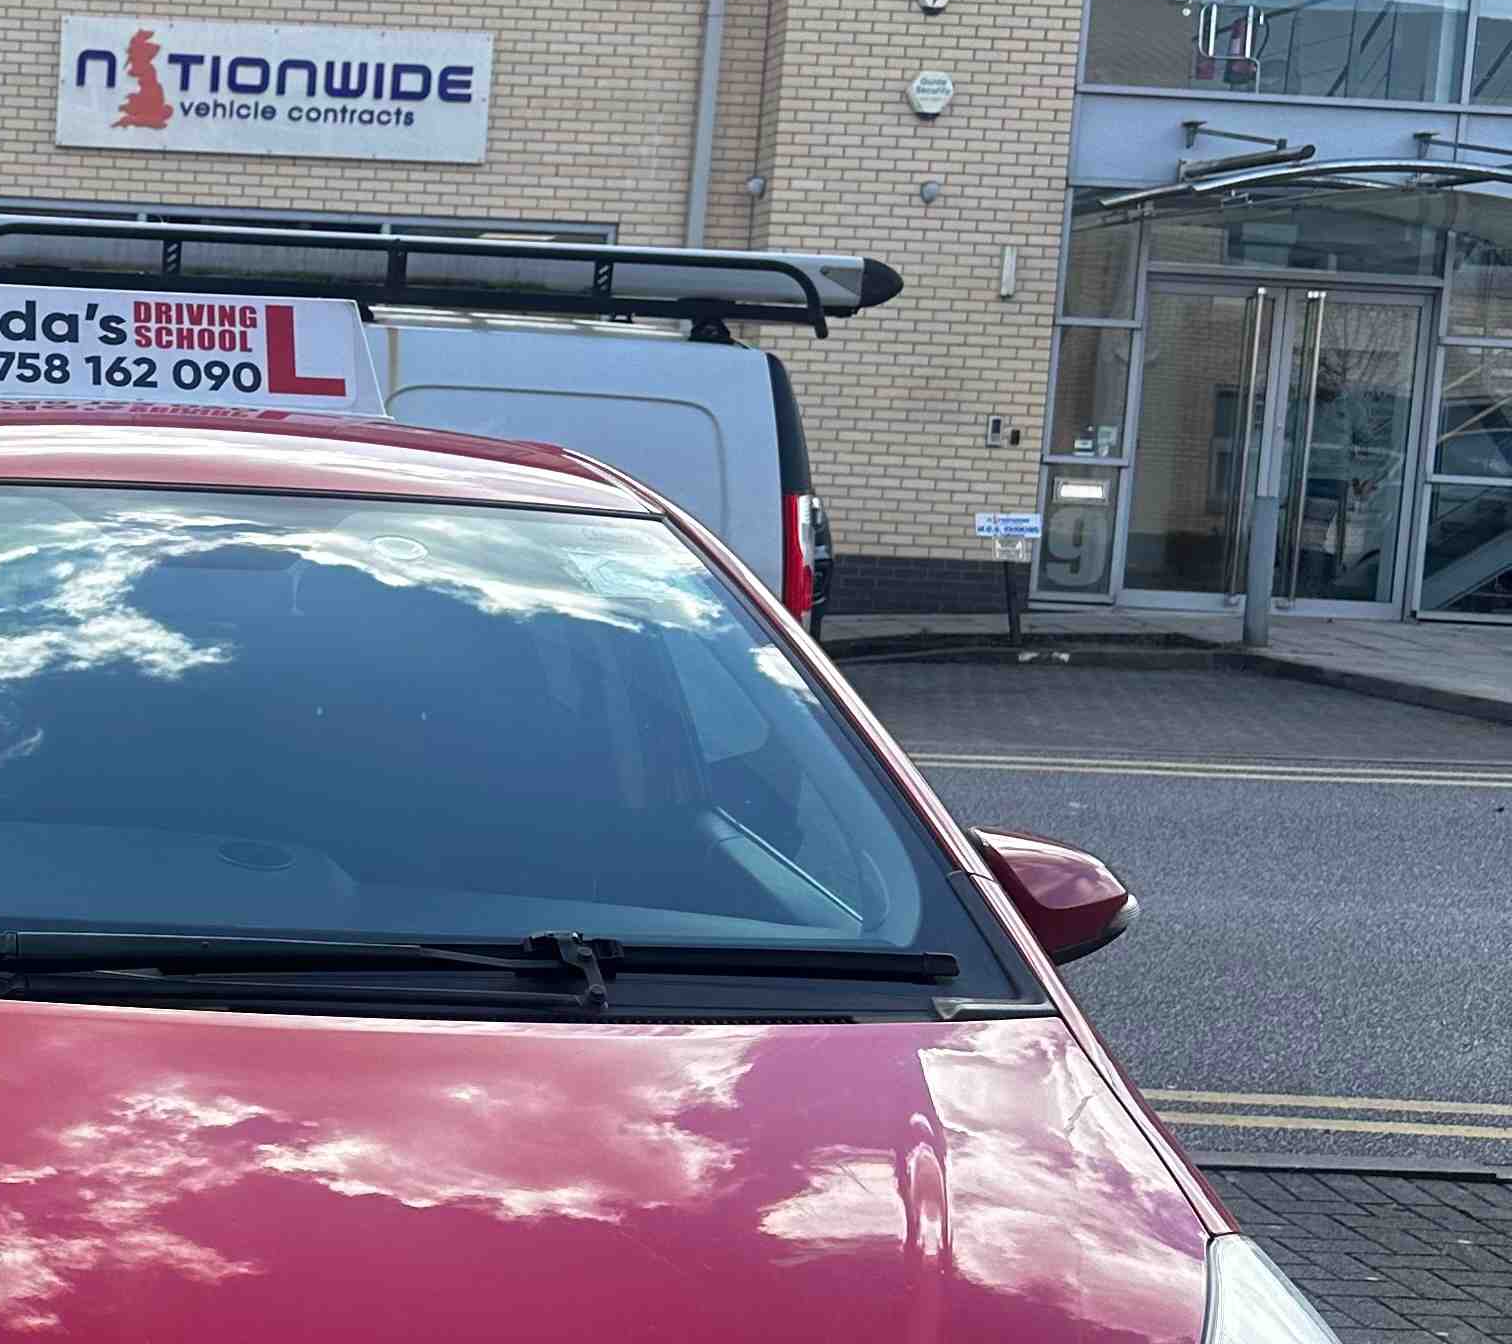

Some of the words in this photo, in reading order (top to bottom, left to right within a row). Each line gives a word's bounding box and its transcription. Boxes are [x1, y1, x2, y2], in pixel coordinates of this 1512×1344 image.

[179, 97, 277, 121] vehicle
[287, 101, 415, 126] contracts
[133, 301, 258, 329] DRIVING
[134, 325, 253, 353] SCHOOL
[265, 305, 347, 397] L
[84, 355, 158, 389] 162
[172, 358, 262, 393] 090
[1045, 507, 1111, 587] 9
